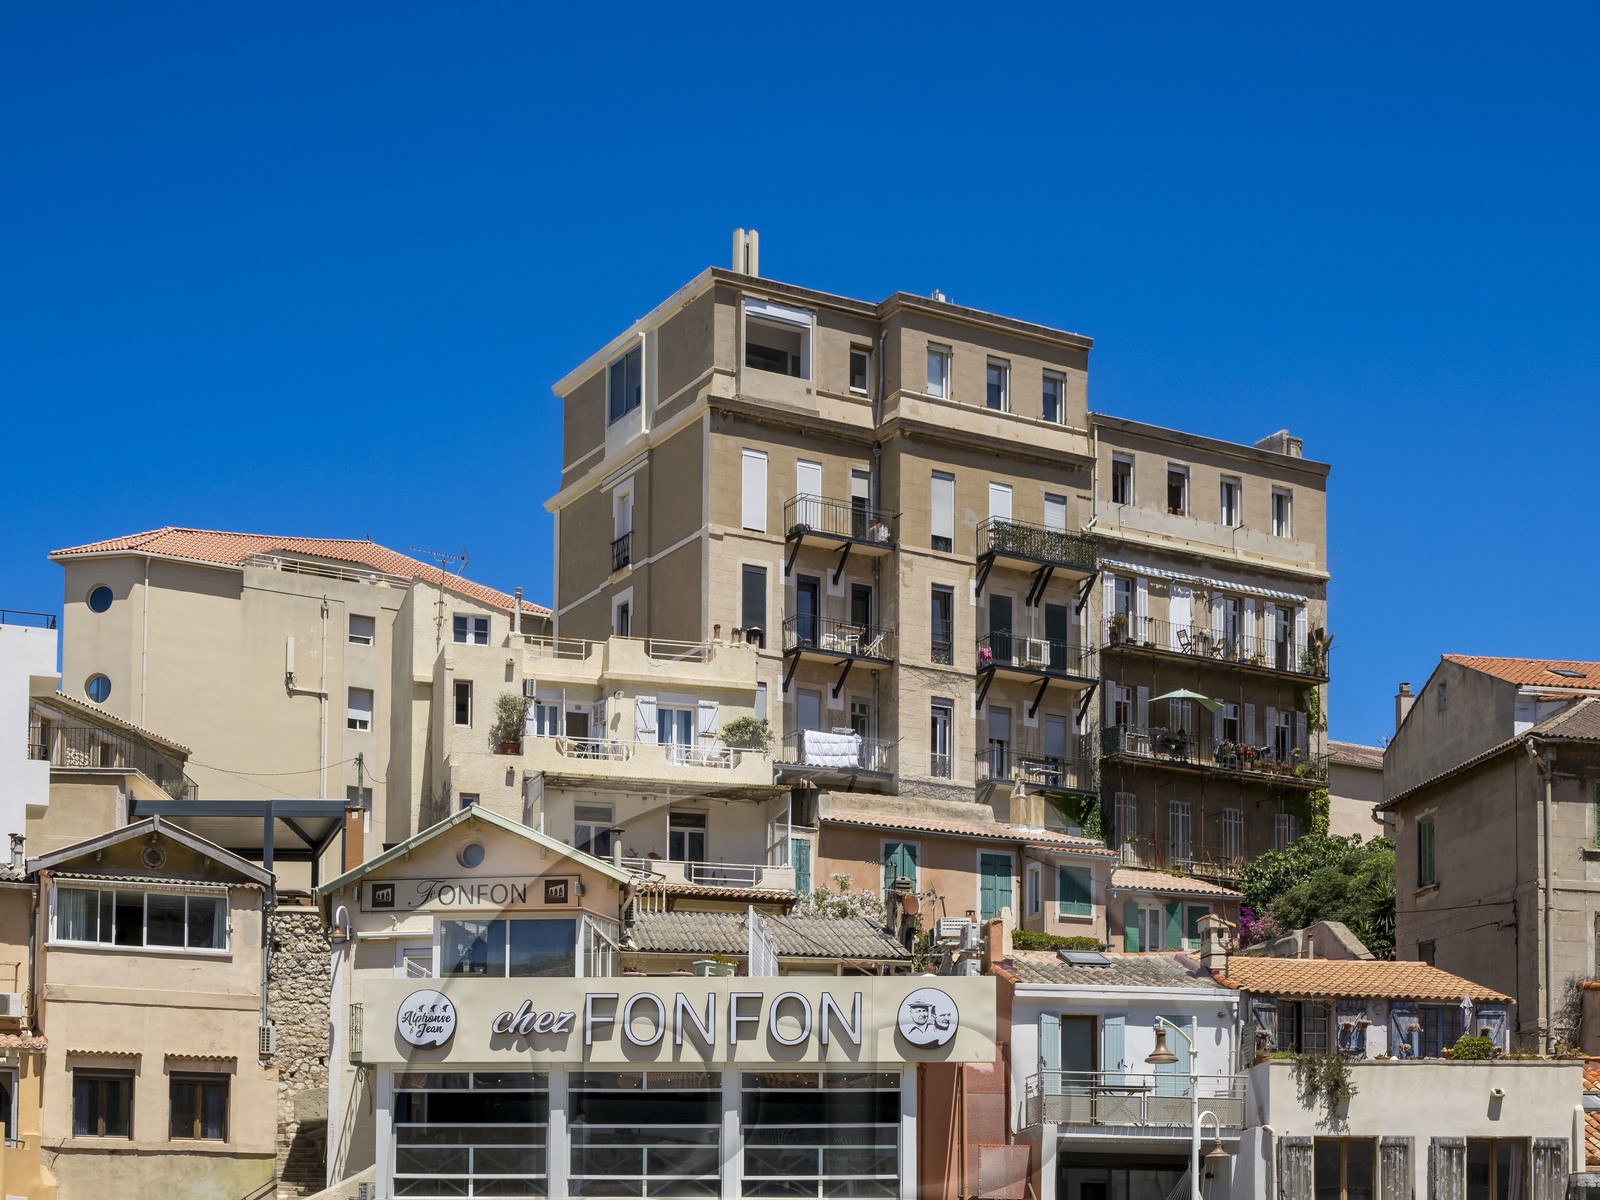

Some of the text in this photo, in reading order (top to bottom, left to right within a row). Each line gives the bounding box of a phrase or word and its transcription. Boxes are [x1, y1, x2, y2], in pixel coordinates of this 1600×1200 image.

[408, 879, 527, 908] FONFON
[401, 1011, 452, 1027] Alphonse
[491, 991, 863, 1047] chez FONFON
[415, 1023, 444, 1038] Jean
